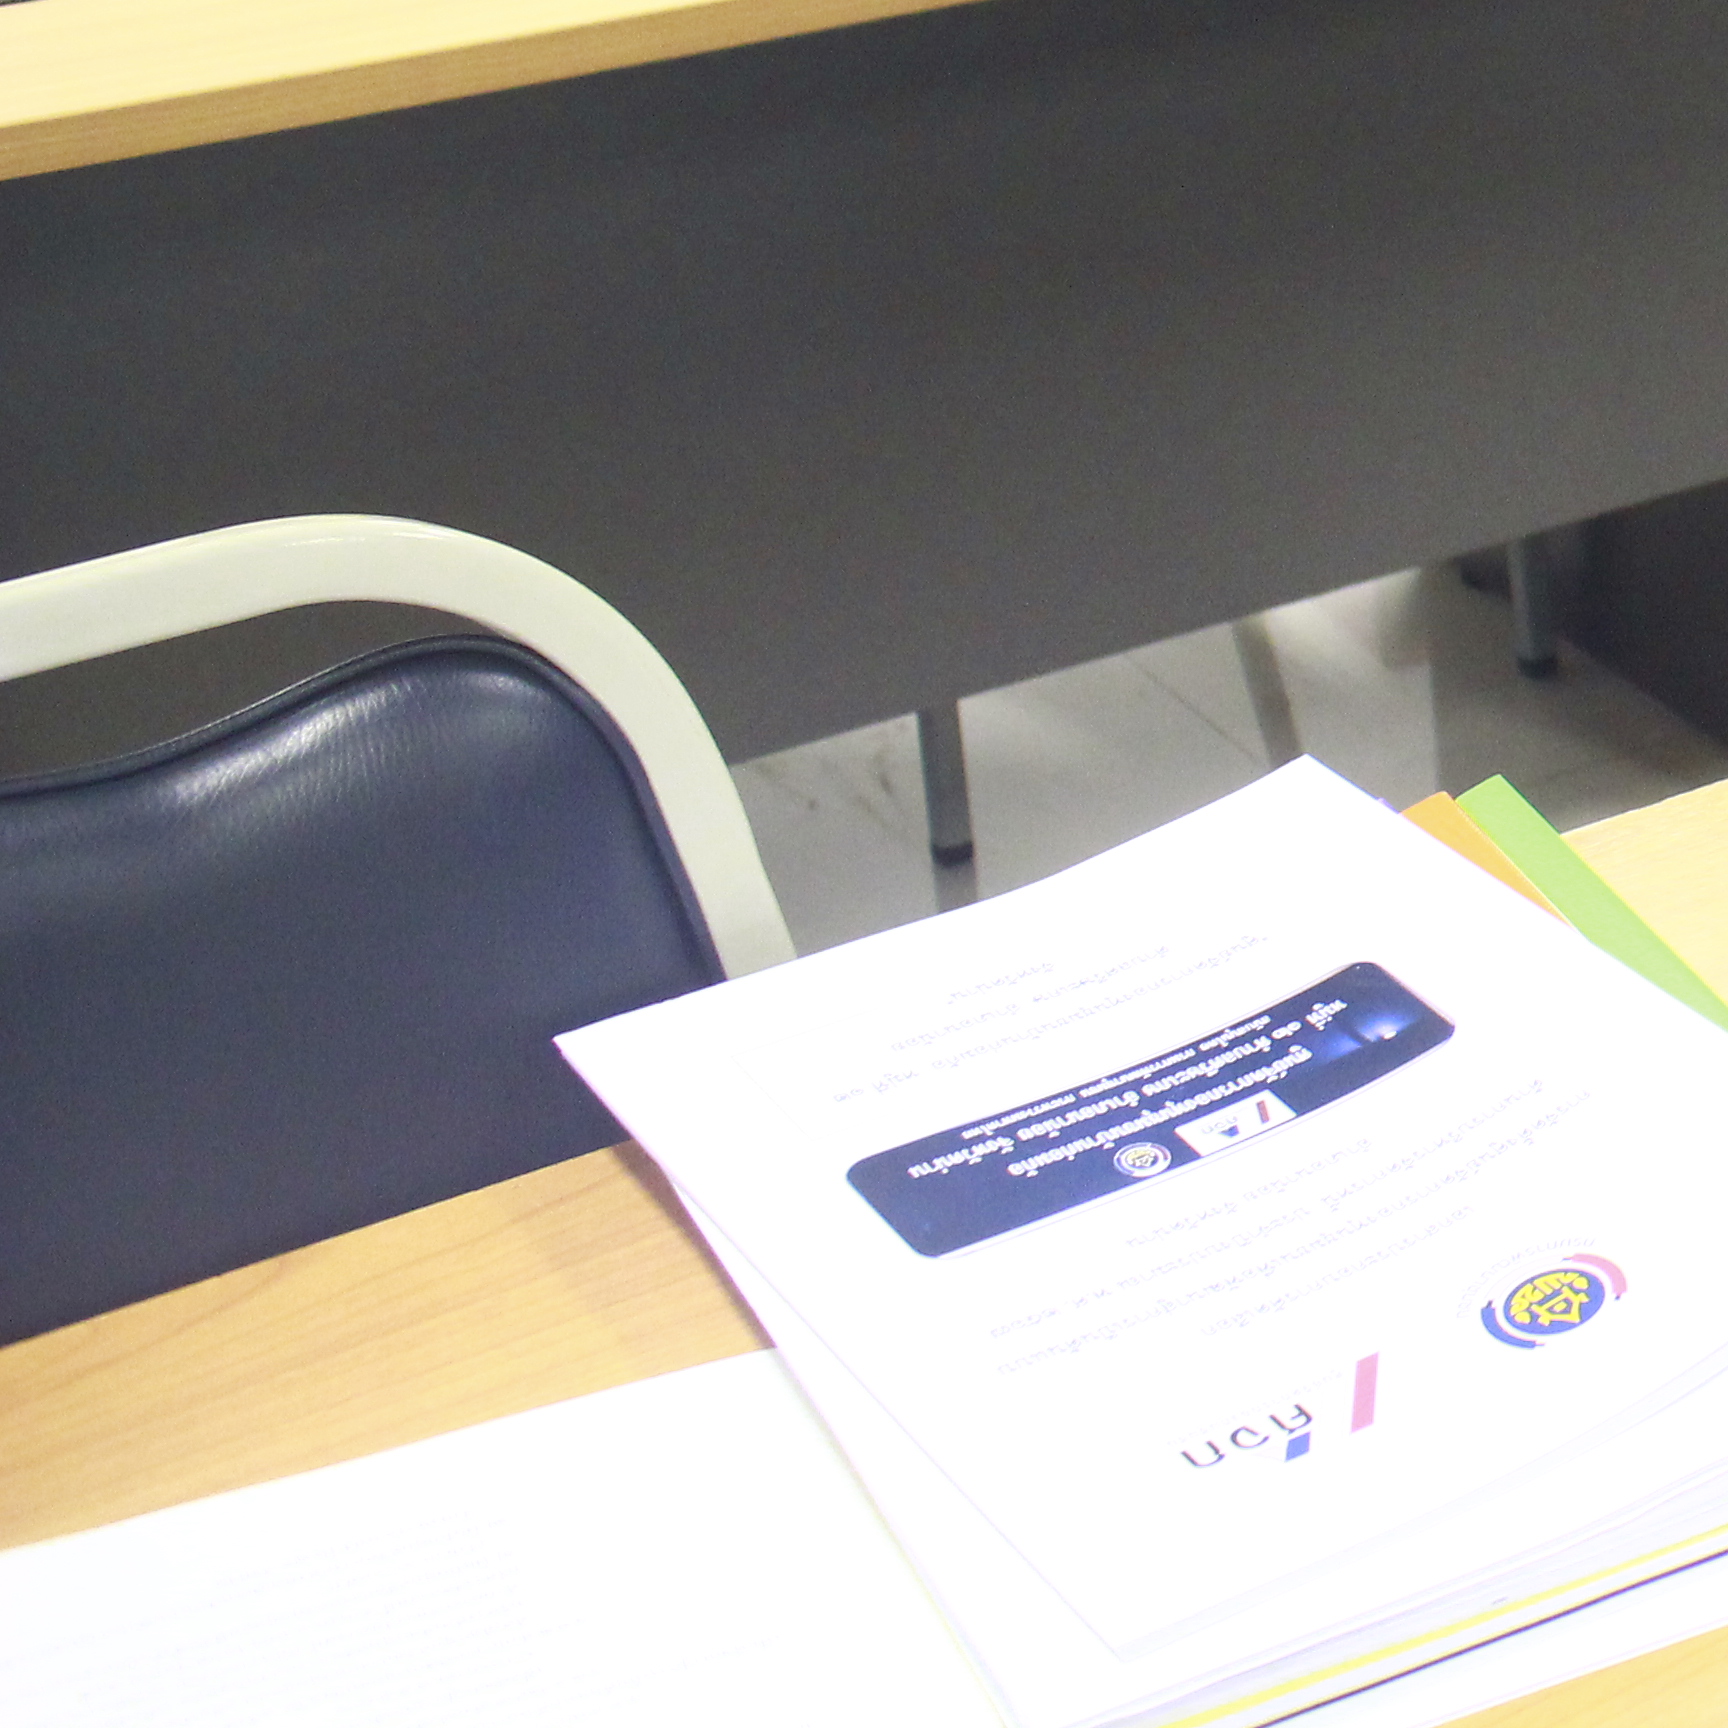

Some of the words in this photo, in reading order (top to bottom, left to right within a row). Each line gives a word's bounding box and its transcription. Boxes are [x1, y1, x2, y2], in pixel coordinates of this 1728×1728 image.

[889, 1000, 1021, 1054] อำเภอนาน้อย
[1269, 1018, 1304, 1042] ๑๒
[1303, 995, 1348, 1032] หมู่ที่
[1005, 1044, 1314, 1179] ศูนย์จัดการกองทุนชุมชนบ้านก่อมก้อ
[1015, 1086, 1141, 1143] อำเภอนาน้อย
[907, 1132, 1016, 1181] จังหวัดน่าน
[1240, 1134, 1373, 1204] อำเภอนาน้อย
[1318, 1076, 1545, 1210] ด้านการบริหารจัดการหนี้
[1113, 1203, 1310, 1293] ประจำปีงบประมาณ
[1122, 1196, 1239, 1252] จังหวัดน่าน
[1198, 1202, 1474, 1337] เอกสารประกอบการคัดเลือก
[1178, 1401, 1313, 1469] ศจก
